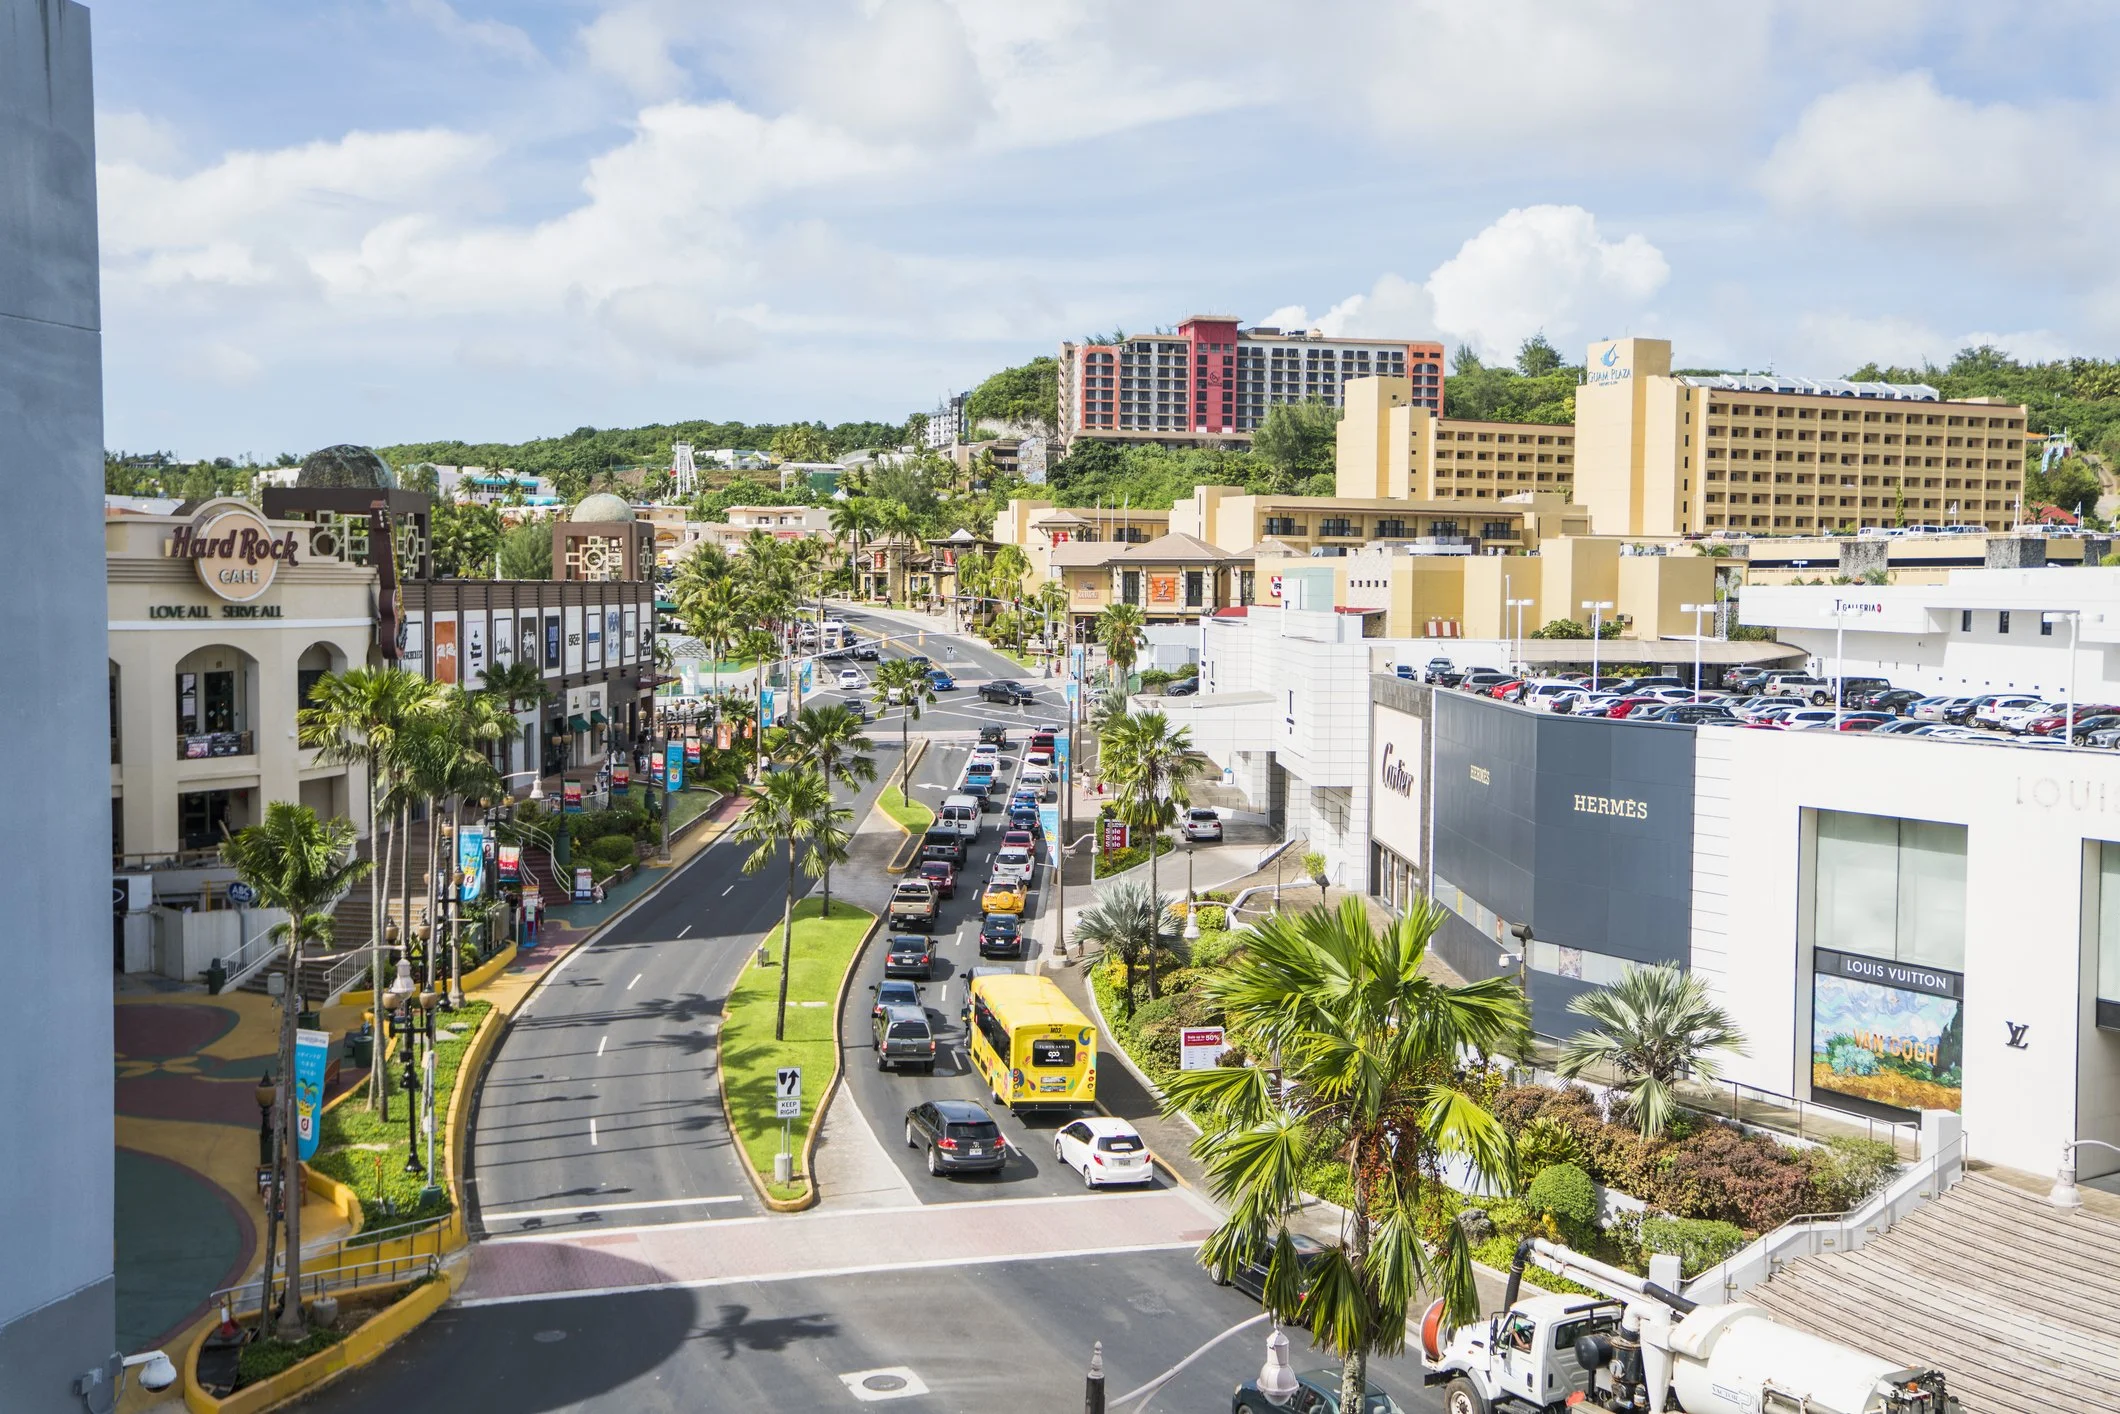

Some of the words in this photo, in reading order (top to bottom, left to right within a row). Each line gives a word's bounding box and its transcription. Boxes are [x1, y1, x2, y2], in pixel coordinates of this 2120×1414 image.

[1588, 371, 1609, 383] GUAM
[1611, 368, 1631, 380] PLAZA
[170, 526, 237, 559] Hard
[239, 528, 299, 566] Rock
[150, 605, 186, 618] LOVE
[187, 605, 211, 618] ALL
[222, 605, 260, 618] SERVE
[261, 605, 284, 618] ALL
[1382, 742, 1414, 799] Cartier
[1573, 794, 1648, 819] HERMÈS
[231, 884, 250, 896] ABC
[1847, 959, 1884, 978] LOUIS
[1888, 967, 1947, 990] VUITTON
[1853, 1028, 1884, 1056] VAN
[1889, 1036, 1939, 1066] GOGH
